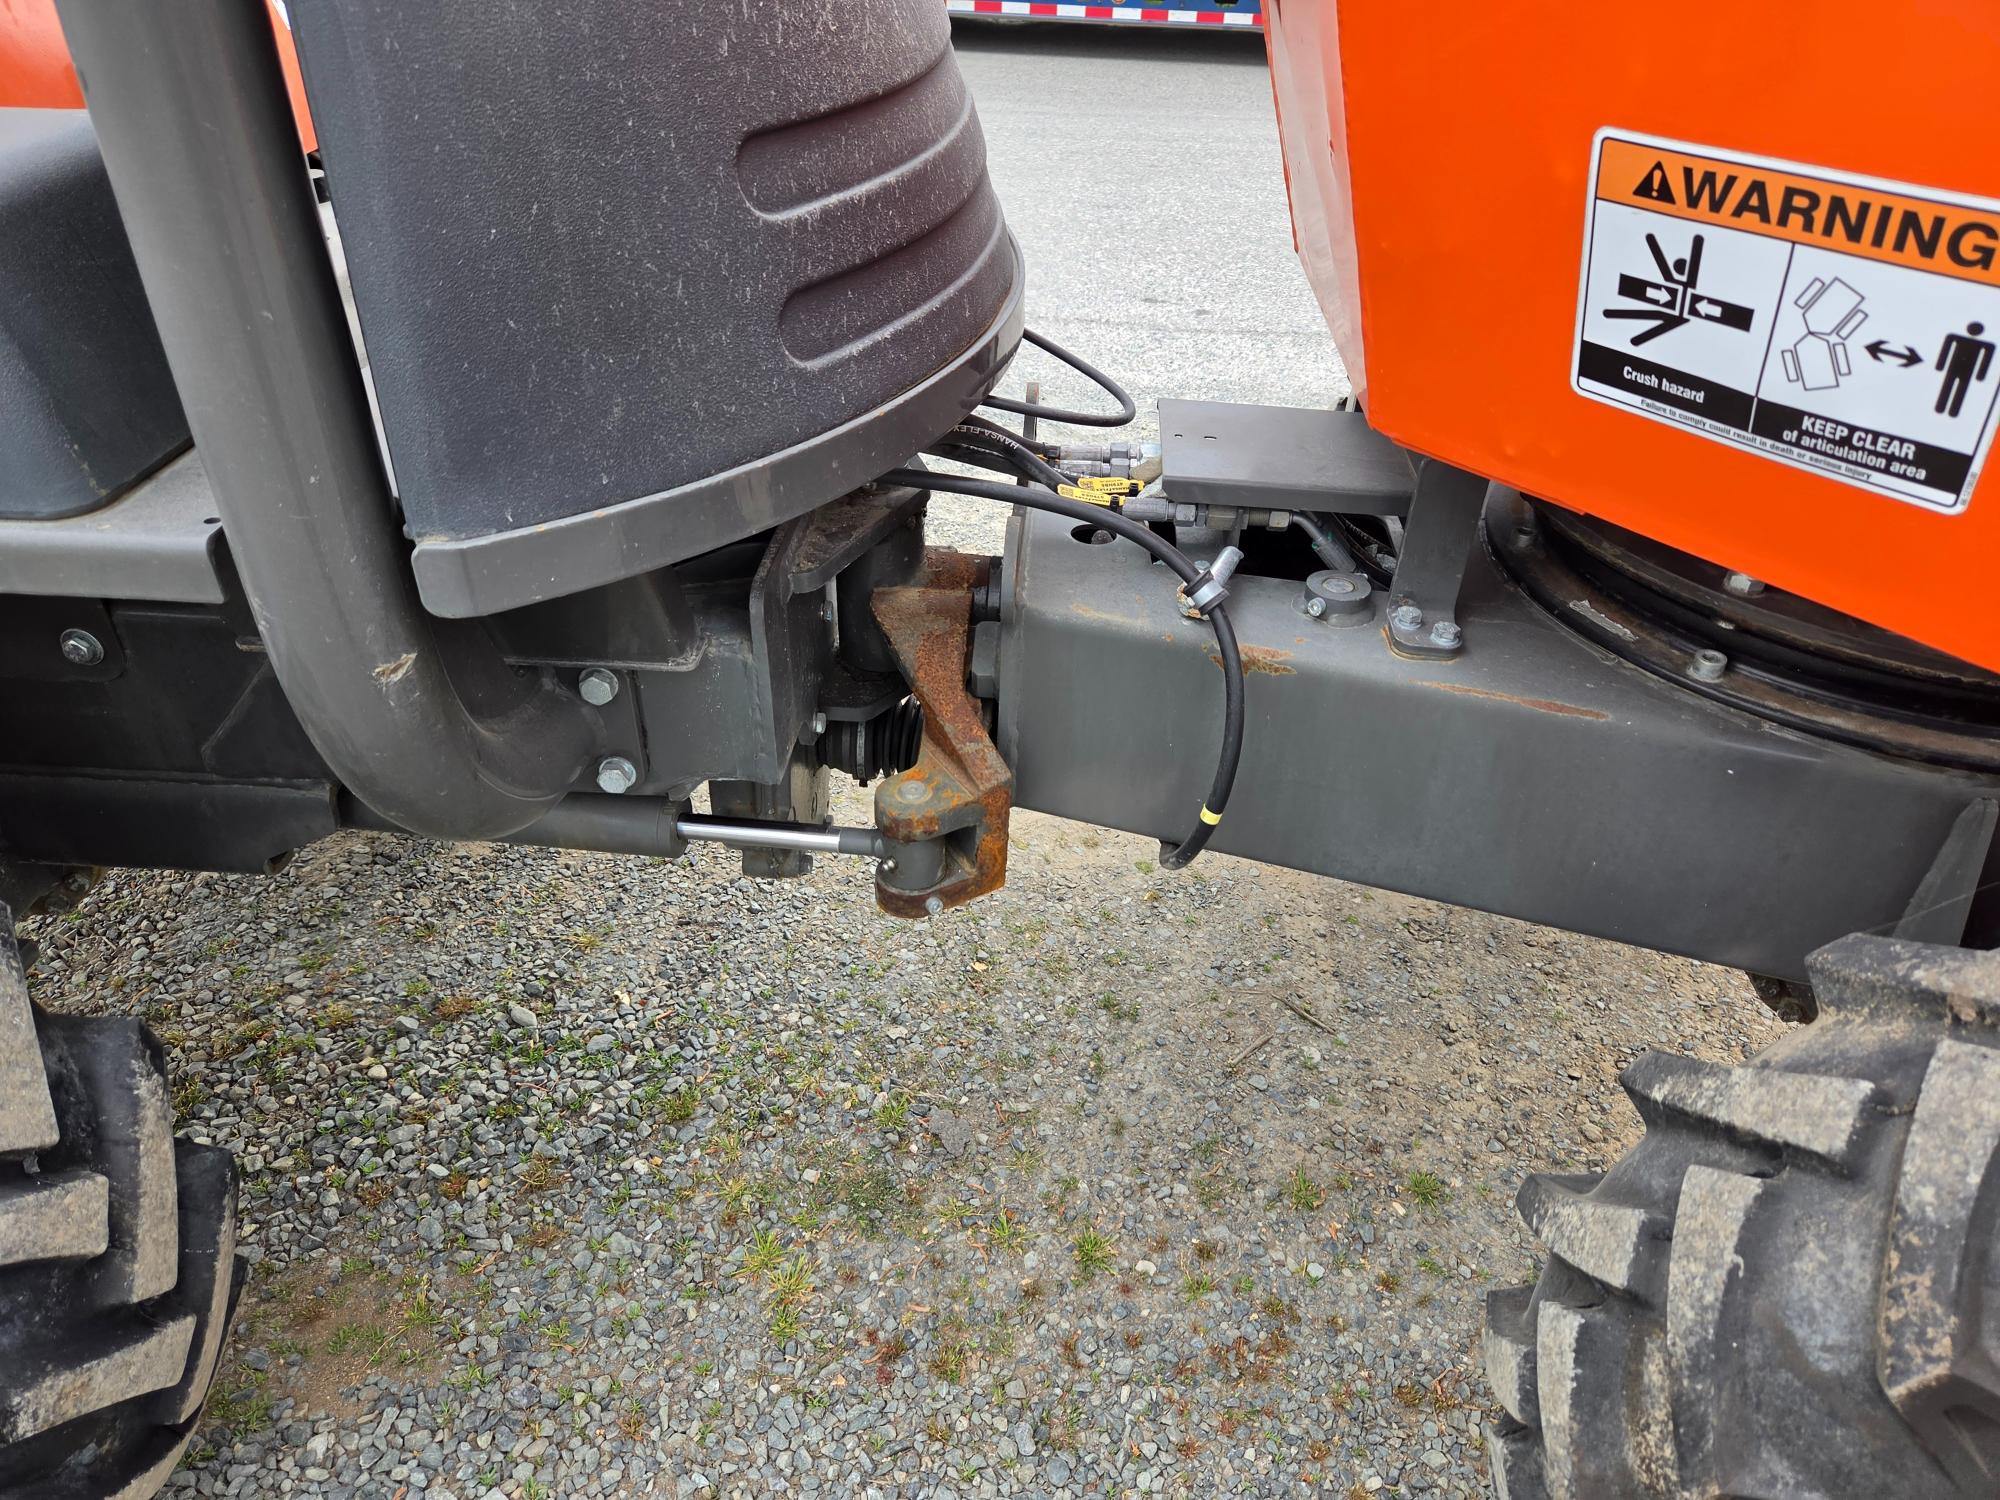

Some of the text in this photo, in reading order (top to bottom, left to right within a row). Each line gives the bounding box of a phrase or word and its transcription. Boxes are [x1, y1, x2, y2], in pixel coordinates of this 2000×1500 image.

[1682, 166, 1999, 271] WARNING
[1623, 365, 1705, 403] Crush hazard
[1640, 399, 1872, 481] Failure to comply could result in death or serious injury
[1782, 429, 1927, 481] of articulation area
[1801, 415, 1917, 460] KEEP CLEAR
